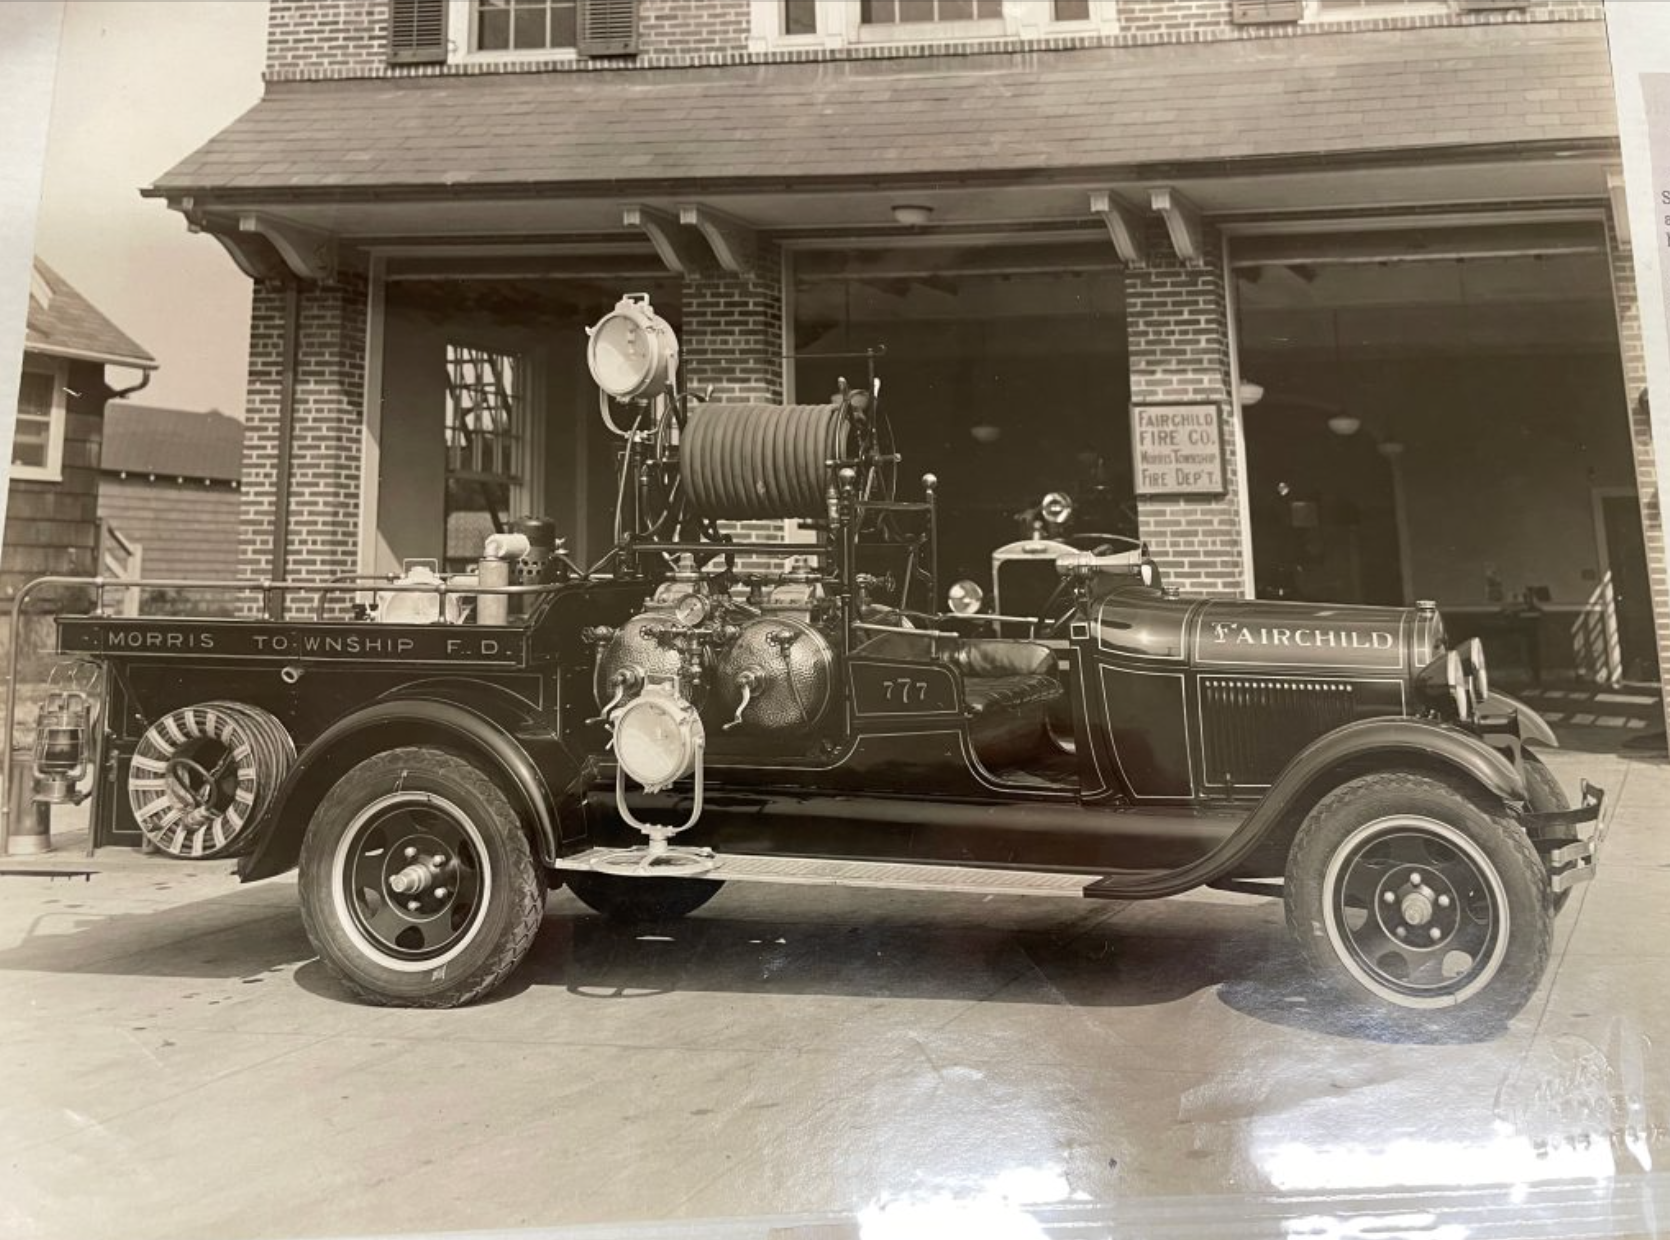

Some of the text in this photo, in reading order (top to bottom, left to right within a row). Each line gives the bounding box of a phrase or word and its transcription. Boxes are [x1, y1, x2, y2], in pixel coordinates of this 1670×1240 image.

[1138, 410, 1213, 428] FAIRCHILD
[1140, 429, 1216, 446] FIRE CO.
[1141, 468, 1169, 487] FIRE
[108, 631, 215, 648] MORRIS
[252, 635, 415, 654] TOWNSHIP
[1211, 621, 1394, 650] FAIRCHILD
[883, 678, 928, 704] 777
